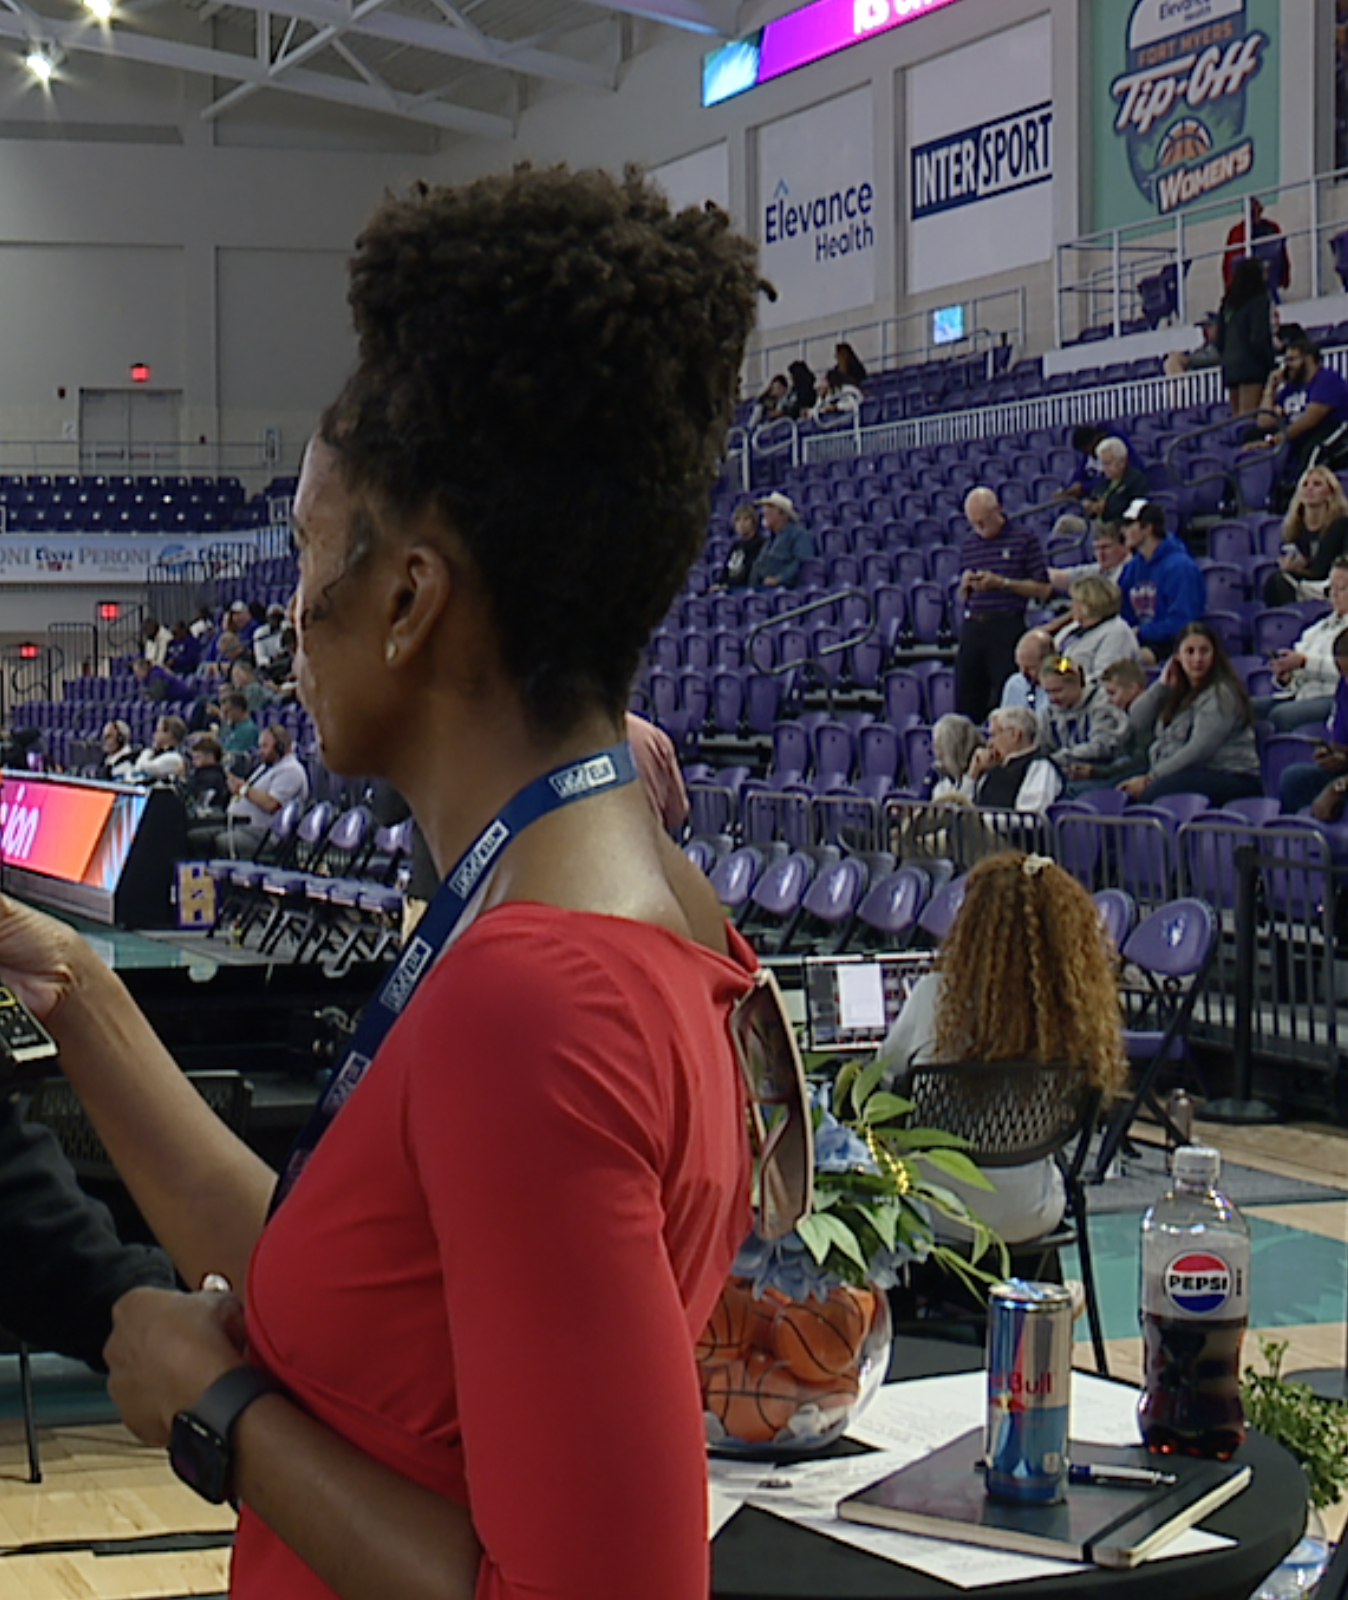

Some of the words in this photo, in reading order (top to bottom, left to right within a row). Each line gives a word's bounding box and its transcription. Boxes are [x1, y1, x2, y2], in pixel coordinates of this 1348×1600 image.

[1113, 34, 1262, 134] Tip-Off
[766, 182, 873, 244] Elevance
[816, 219, 874, 262] Health
[79, 546, 151, 565] PERONI
[1169, 1275, 1228, 1290] PEPSI
[1009, 1372, 1051, 1395] Bull
